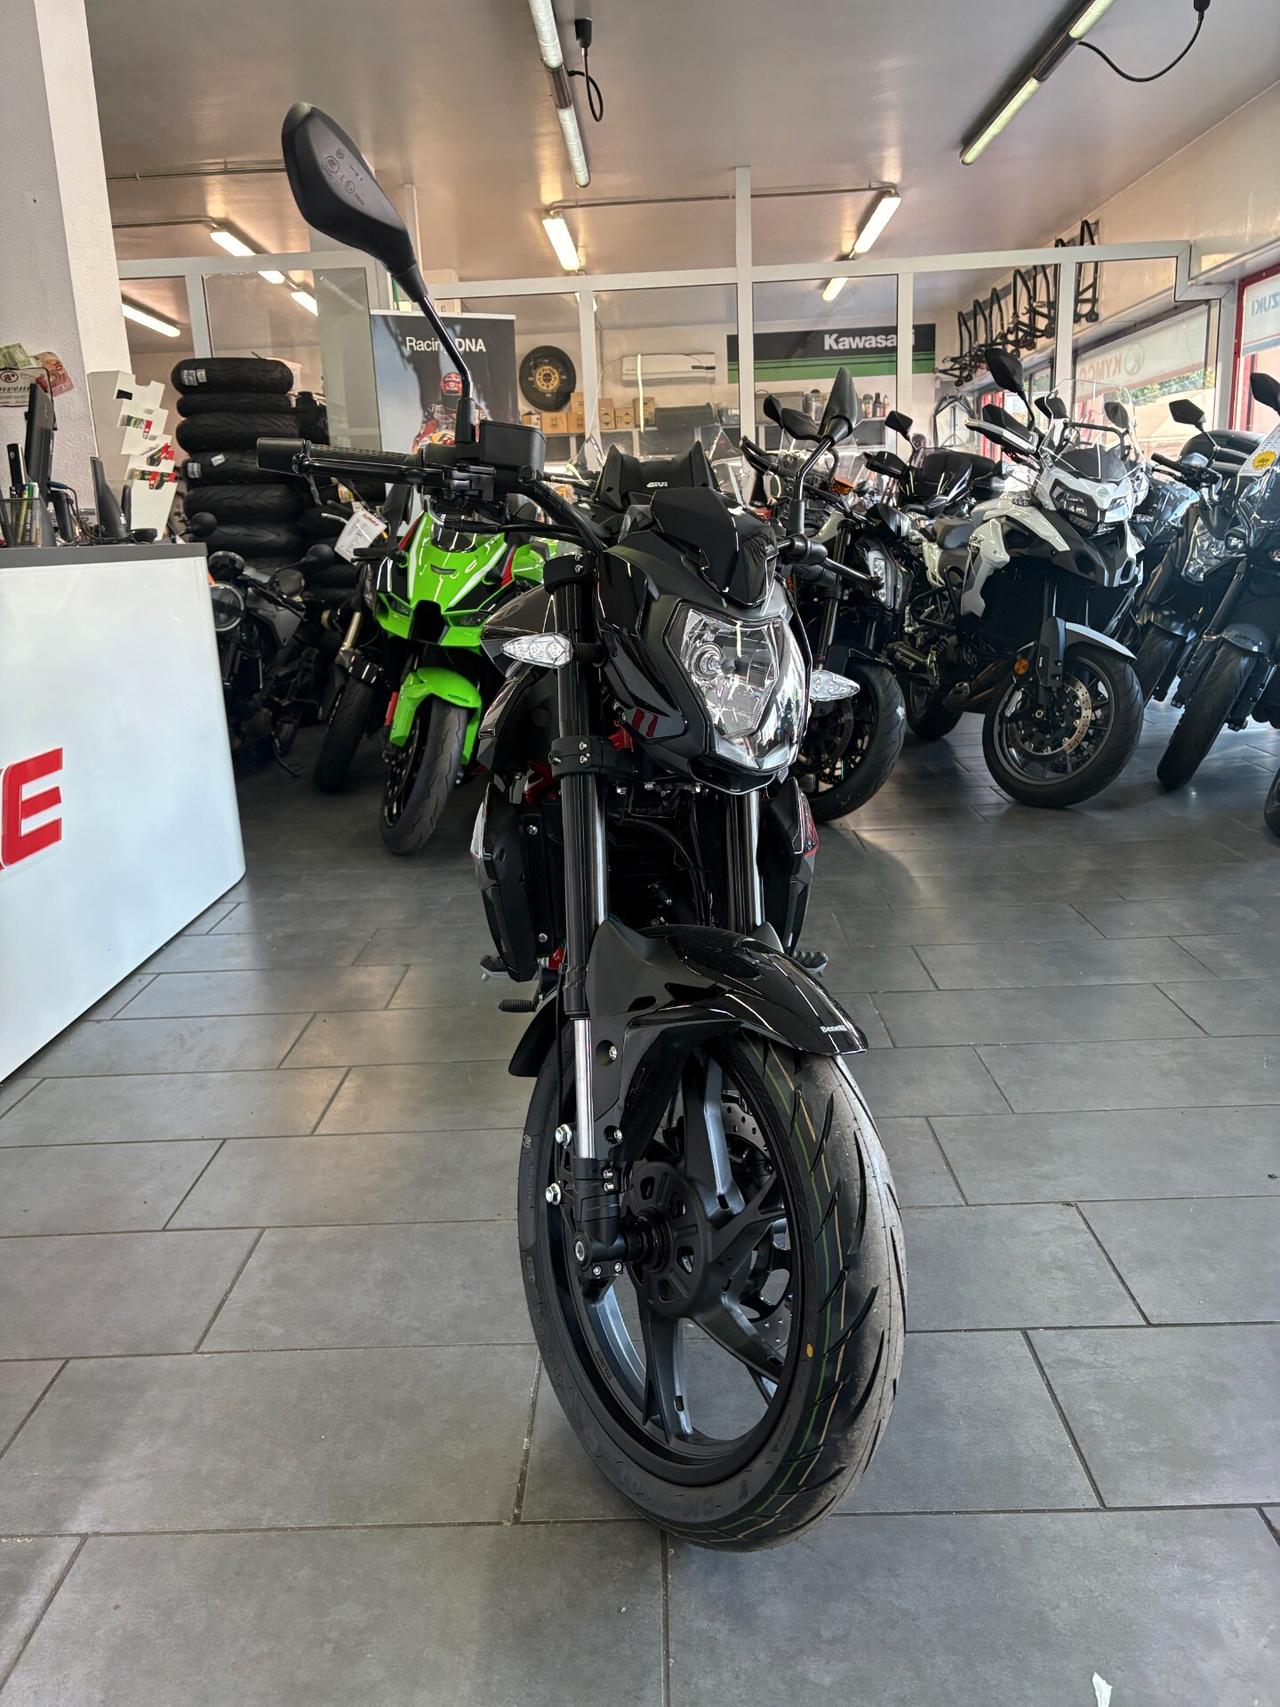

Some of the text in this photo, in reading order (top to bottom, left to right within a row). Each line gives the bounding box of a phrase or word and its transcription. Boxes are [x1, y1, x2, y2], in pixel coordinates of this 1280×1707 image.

[405, 336, 486, 354] Racin DNA
[824, 329, 915, 350] Kawasai
[0, 747, 63, 871] E
